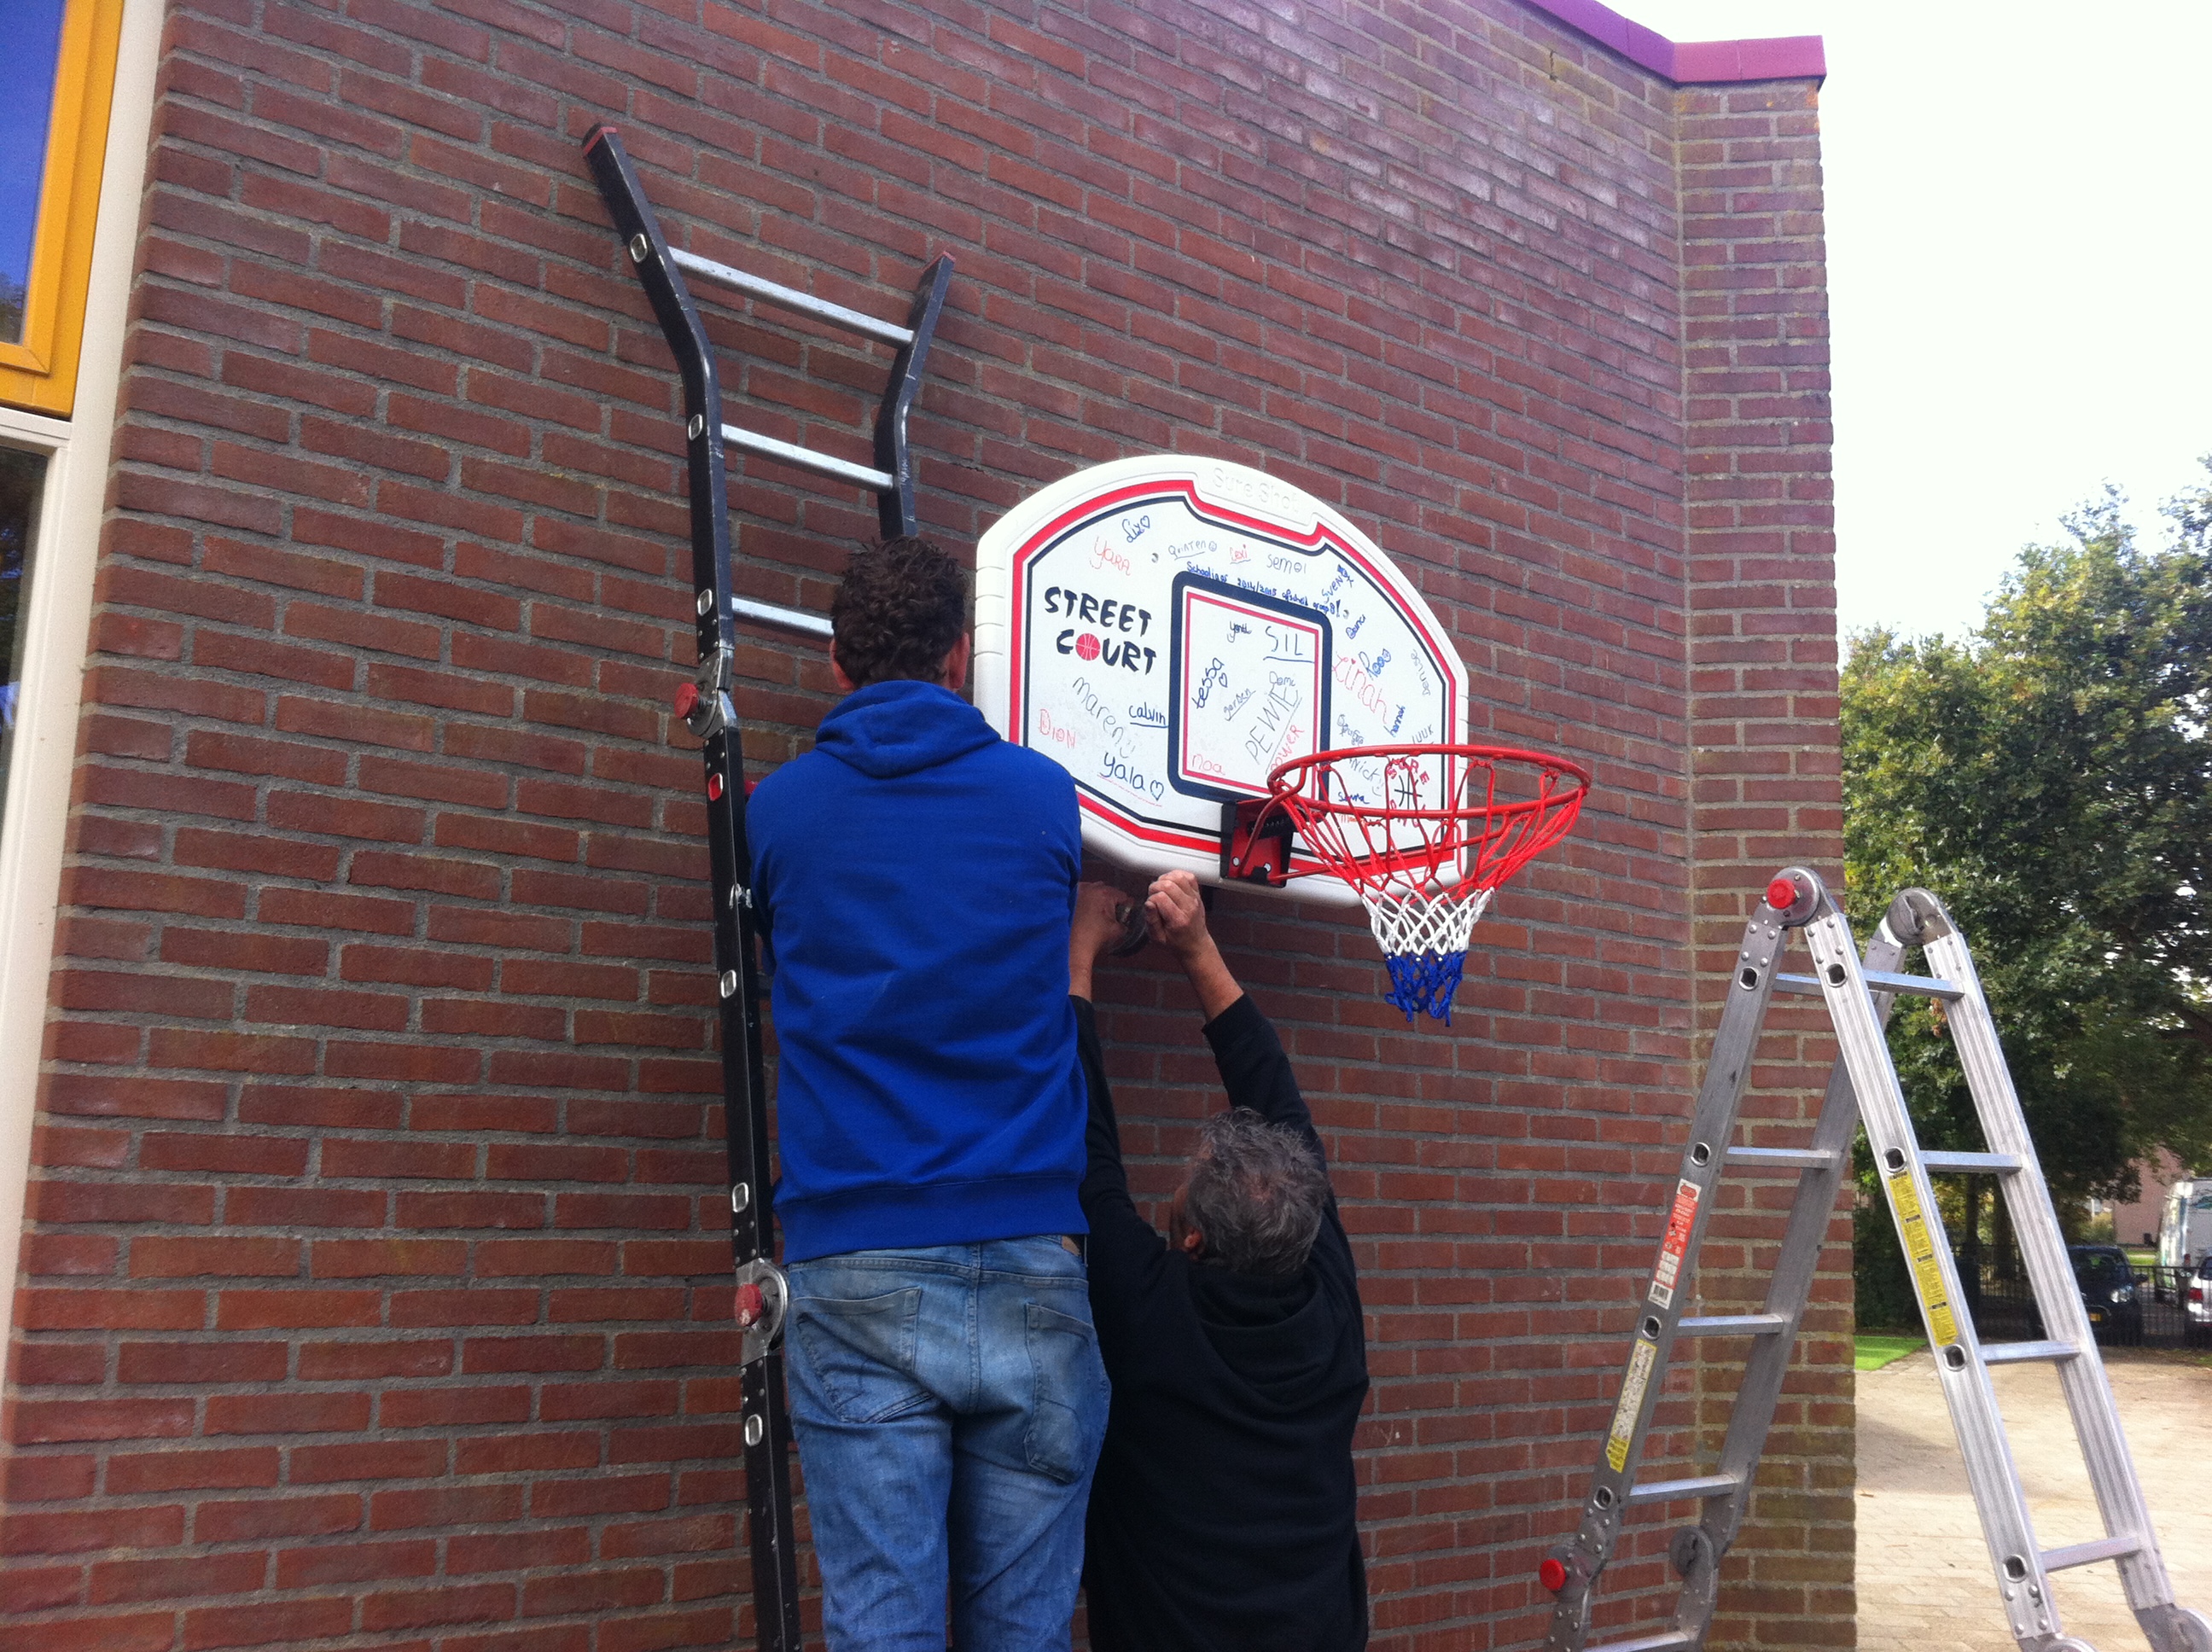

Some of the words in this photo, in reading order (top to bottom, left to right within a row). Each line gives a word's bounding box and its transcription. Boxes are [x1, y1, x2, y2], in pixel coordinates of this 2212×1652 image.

[1212, 467, 1254, 497] Sure
[1237, 578, 1278, 596] 2014/2015
[1045, 586, 1151, 637] STREET
[1056, 629, 1157, 675] COURT
[1265, 625, 1304, 656] SIL
